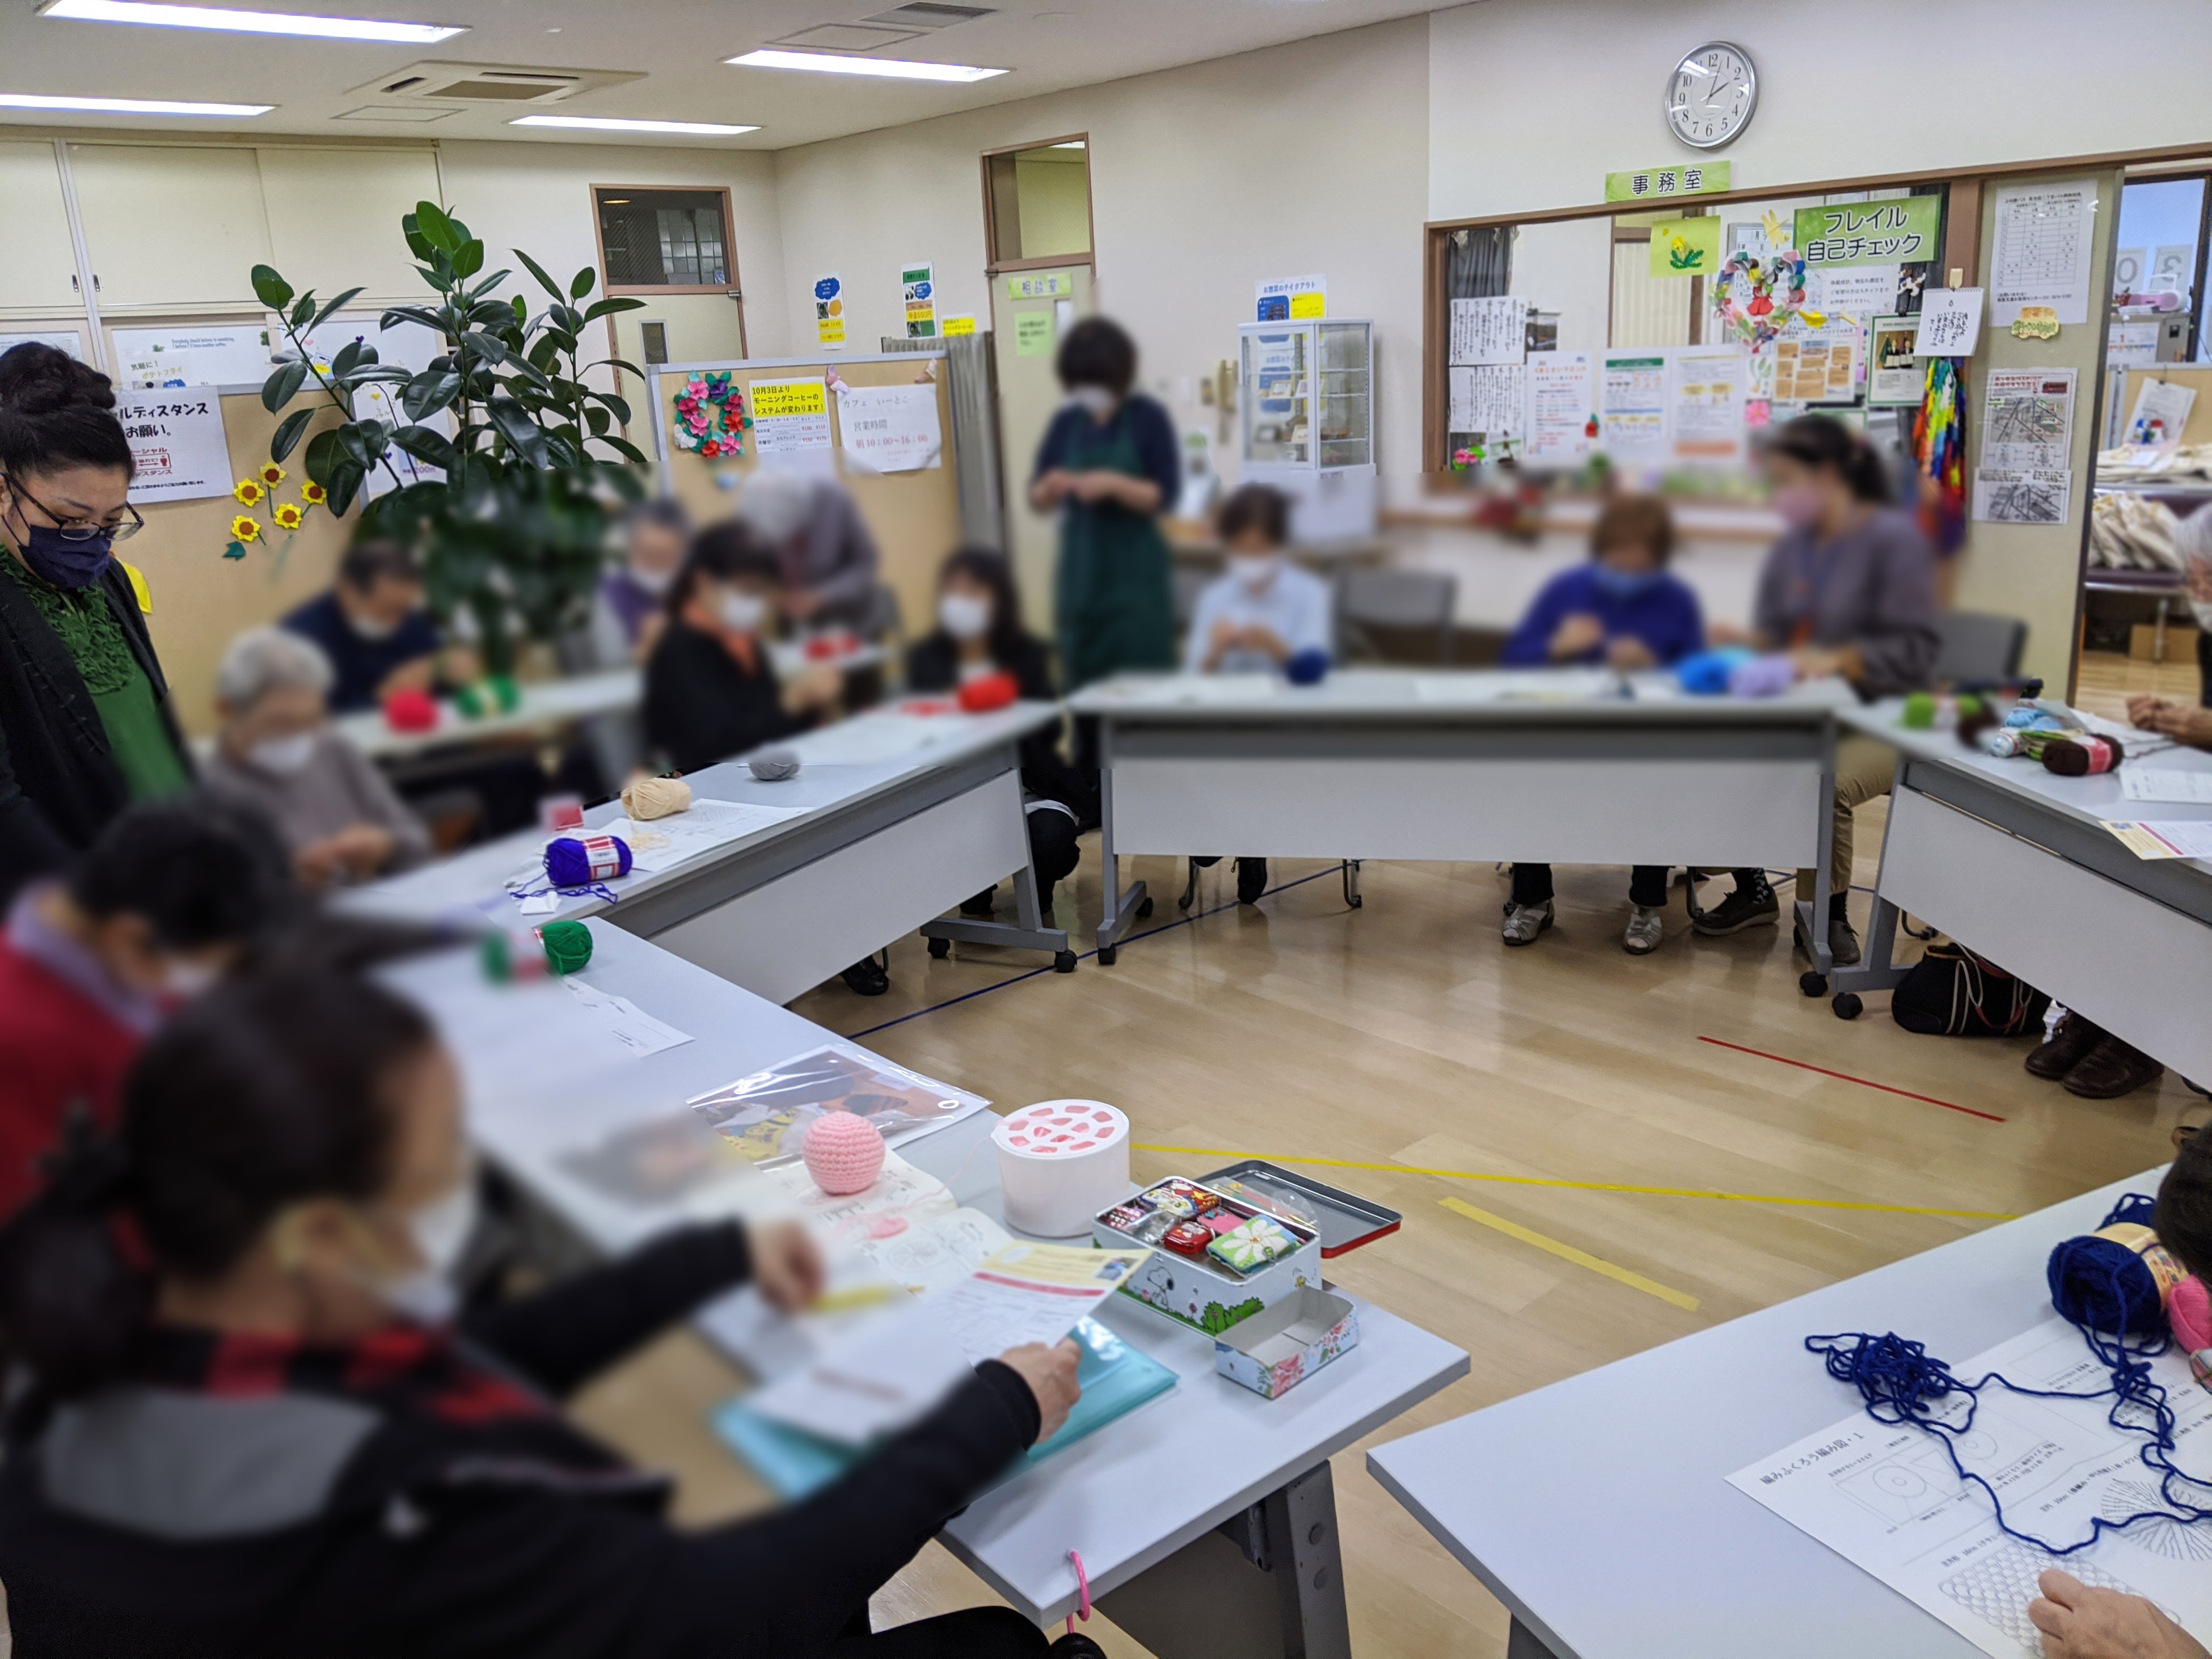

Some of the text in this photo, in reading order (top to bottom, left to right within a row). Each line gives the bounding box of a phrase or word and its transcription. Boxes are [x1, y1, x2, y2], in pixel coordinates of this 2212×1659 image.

[1708, 54, 1718, 67] 12
[1725, 56, 1730, 69] 1
[1734, 67, 1741, 80] 2
[1683, 75, 1692, 87] 10
[1679, 92, 1686, 105] 9
[1682, 109, 1689, 123] 8
[1732, 104, 1738, 116] 4
[1692, 121, 1699, 134] 7
[1721, 117, 1728, 130] 5
[1706, 124, 1712, 137] 6
[1632, 169, 1702, 195] 事務室
[1825, 206, 1907, 233] フレイル
[1808, 234, 1921, 261] 自己チェック
[1023, 278, 1057, 294] 相談室
[752, 385, 791, 395] 10月3日より
[754, 394, 818, 404] モーニングコーヒーの
[116, 402, 209, 419] ルディスタンス
[754, 403, 824, 415] システムが変わります！
[126, 424, 171, 438] お願い。
[854, 419, 888, 432] 営業時間
[1759, 1432, 1865, 1485] 編みふくろう編み図・1
